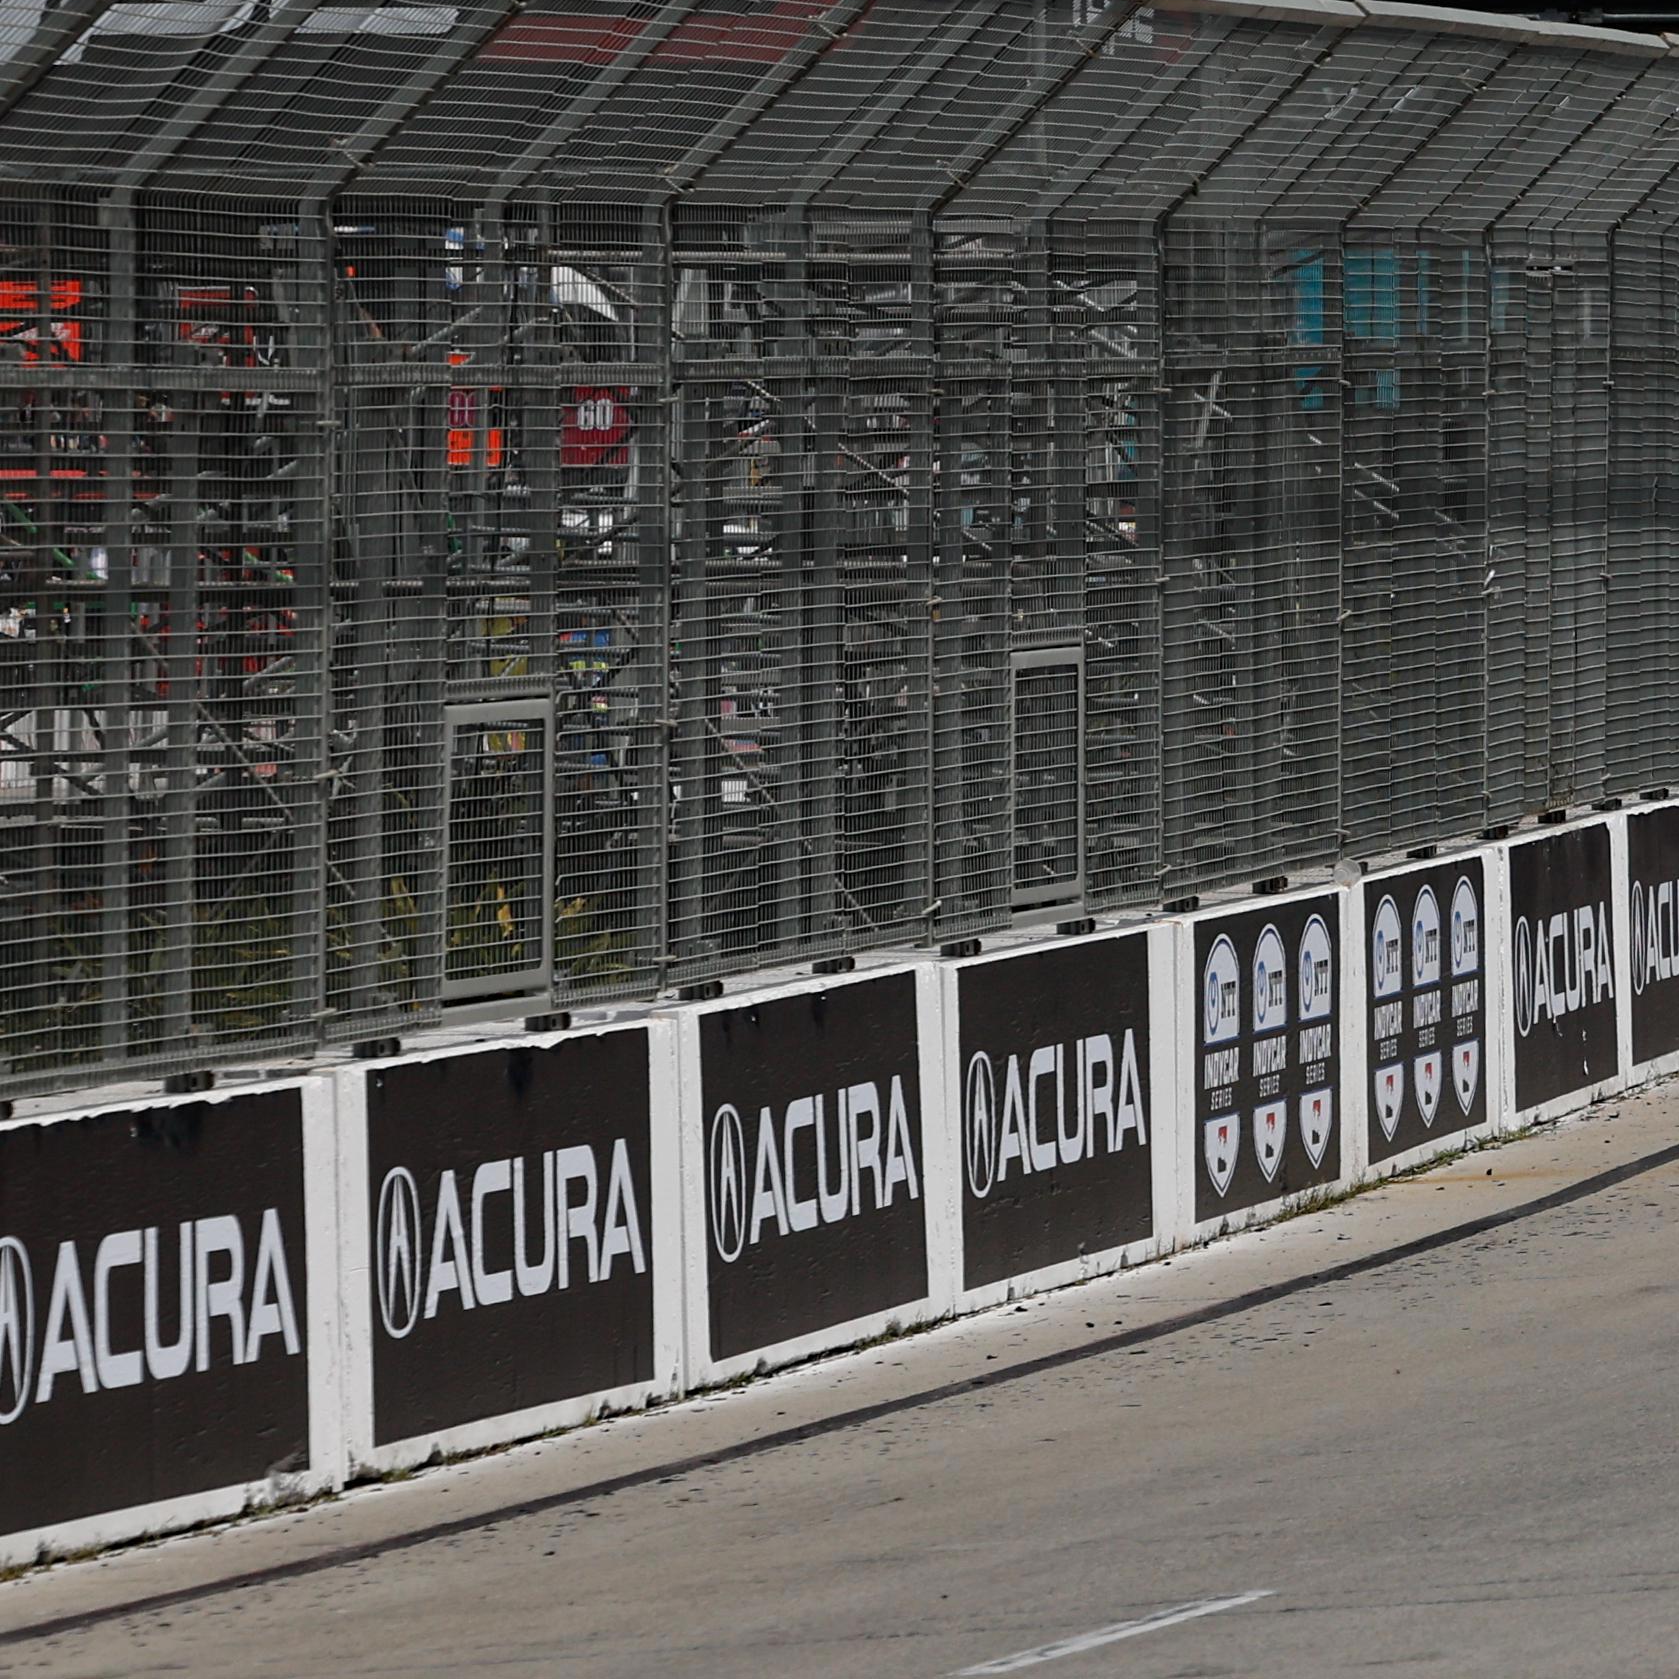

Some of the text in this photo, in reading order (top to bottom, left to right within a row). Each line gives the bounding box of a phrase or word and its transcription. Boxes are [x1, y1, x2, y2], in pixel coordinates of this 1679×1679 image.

[1533, 901, 1614, 1025] ACURA
[997, 1028, 1147, 1182] ACURA
[1204, 1047, 1240, 1090] INDYCAR
[1210, 1087, 1233, 1111] SERIES
[1253, 1035, 1287, 1077] INDYCAR
[423, 1138, 647, 1319] ACURA
[749, 1075, 919, 1245] ACURA
[35, 1208, 300, 1405] ACURA
